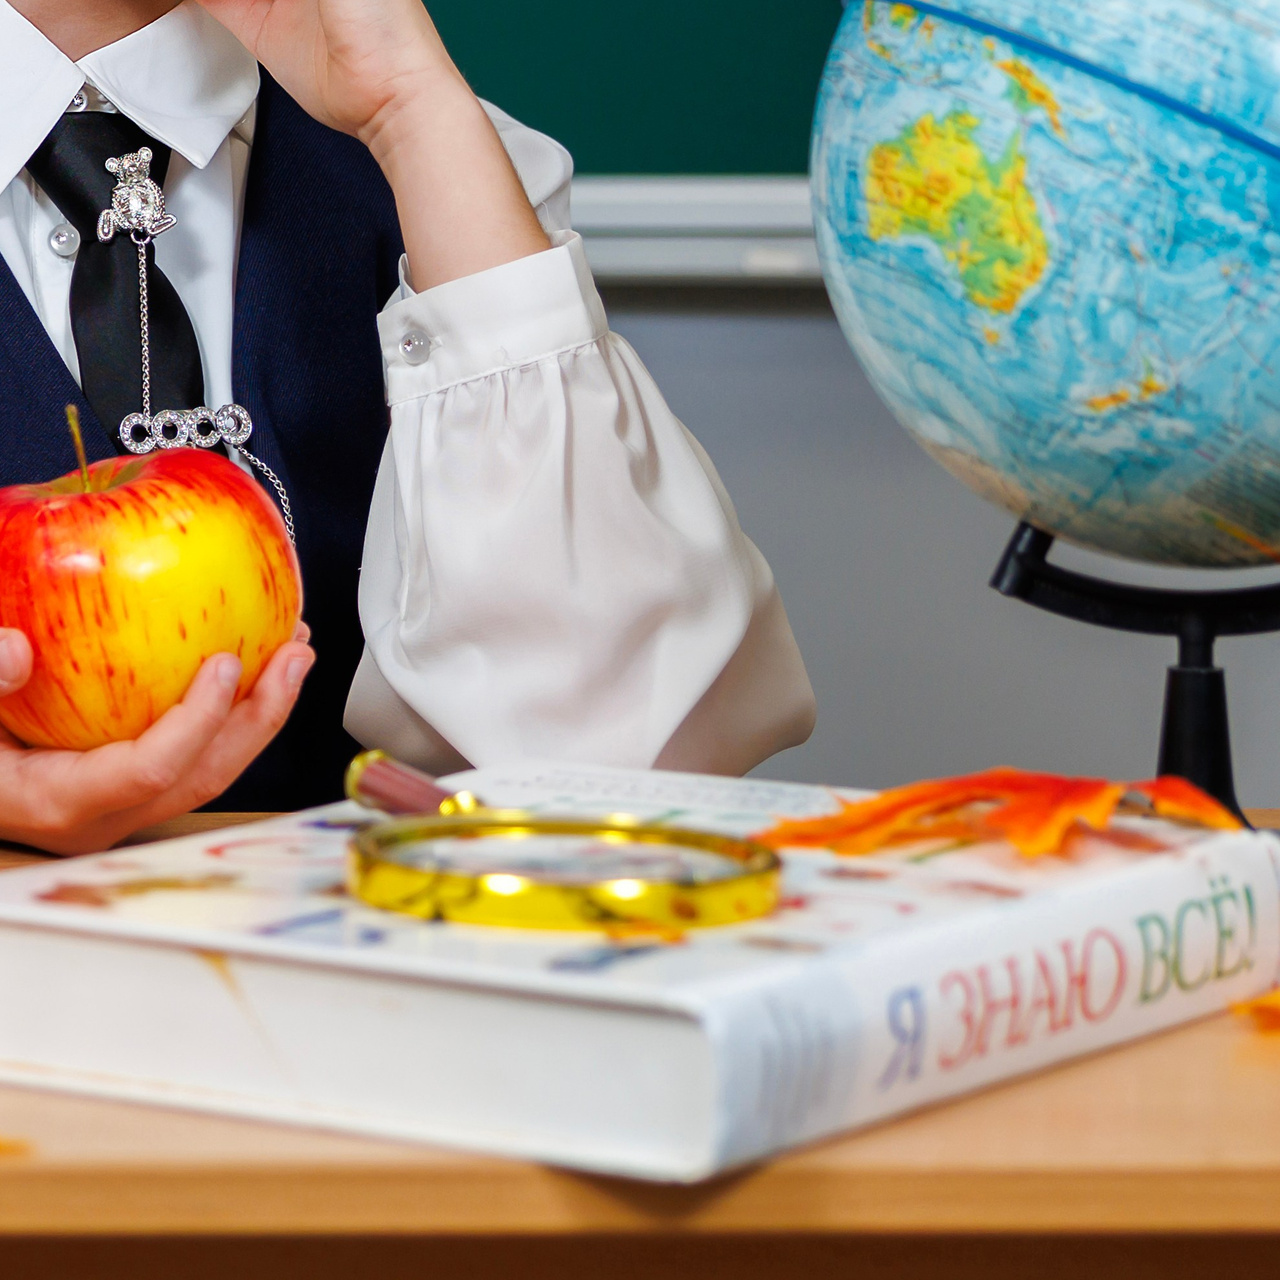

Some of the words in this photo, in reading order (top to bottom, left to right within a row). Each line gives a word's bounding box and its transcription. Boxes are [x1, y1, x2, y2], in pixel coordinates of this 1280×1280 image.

[876, 984, 927, 1093] Я
[935, 927, 1128, 1072] ЗНАЮ
[1135, 875, 1257, 1006] ВСЁ!
